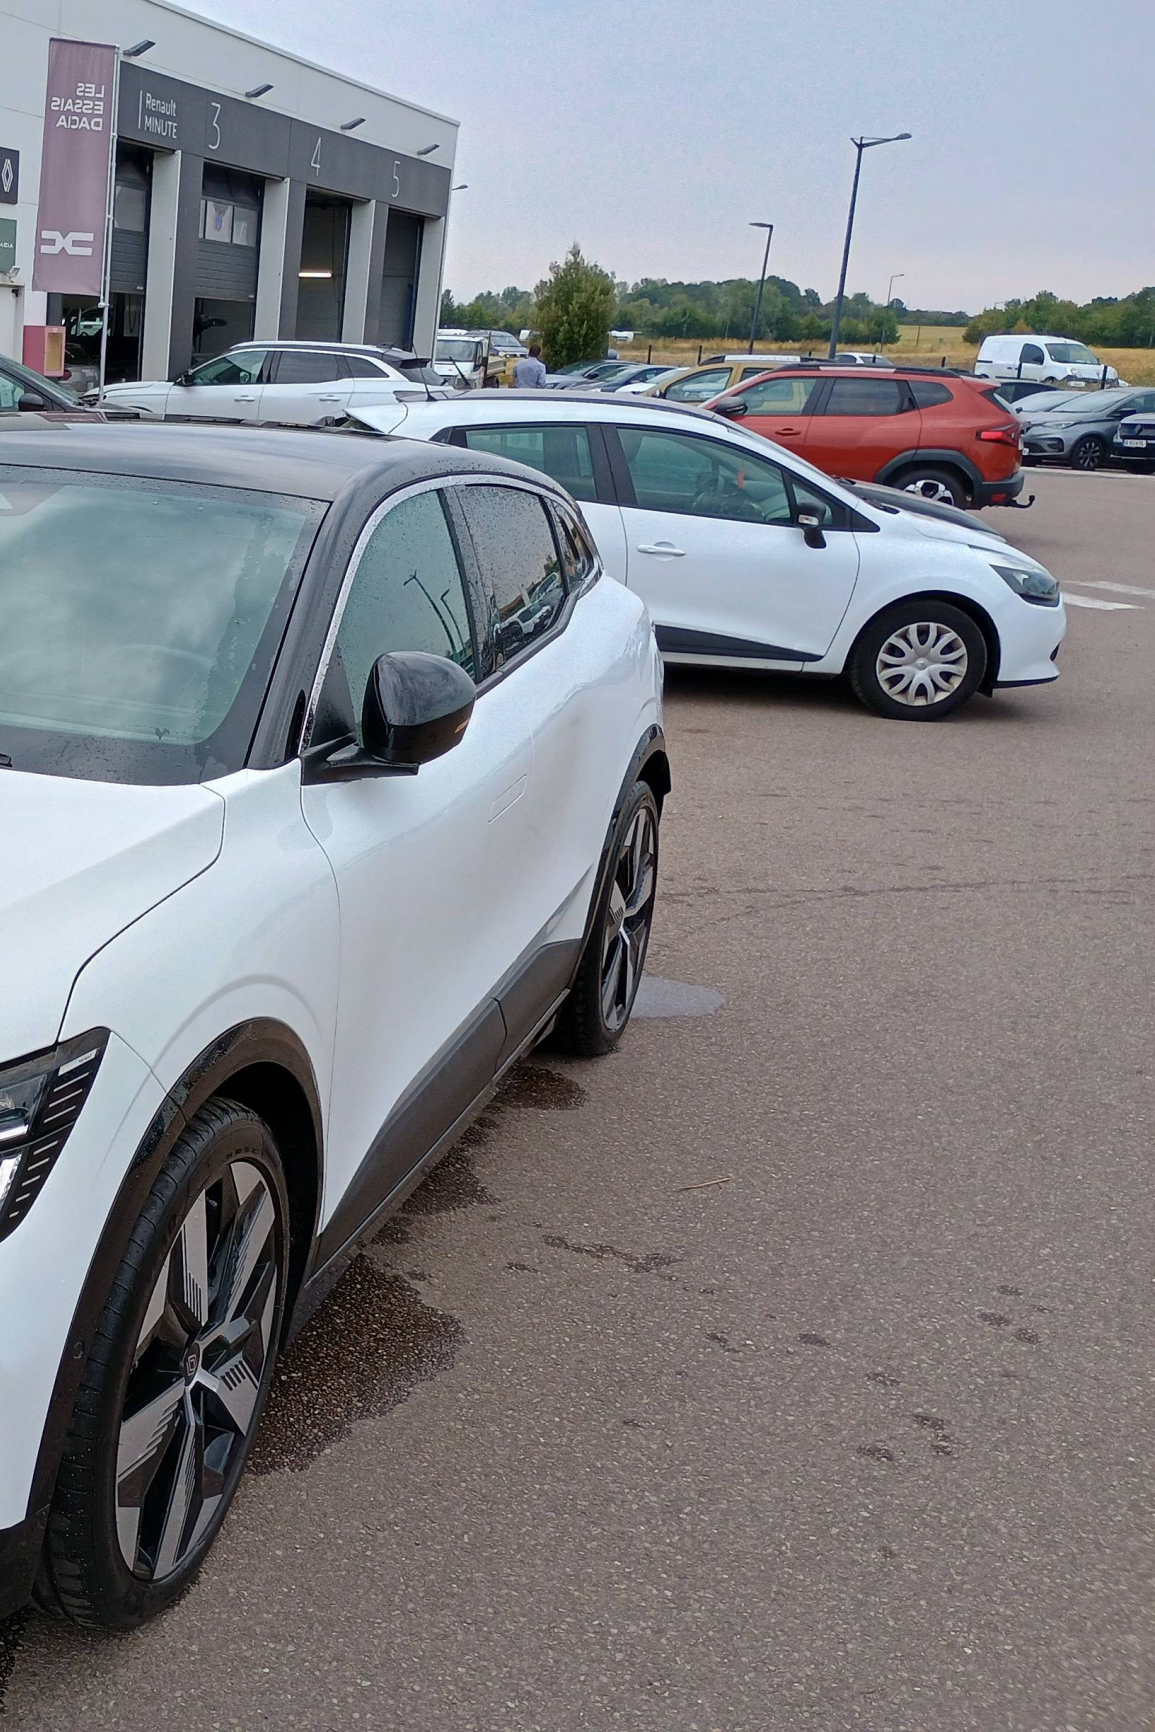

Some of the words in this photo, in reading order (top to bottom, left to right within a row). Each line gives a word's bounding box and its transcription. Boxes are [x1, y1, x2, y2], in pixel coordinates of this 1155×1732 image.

[145, 93, 177, 117] Renault
[144, 115, 178, 139] MINUTE
[208, 102, 222, 150] 3
[310, 137, 322, 177] 4
[391, 161, 401, 198] 5
